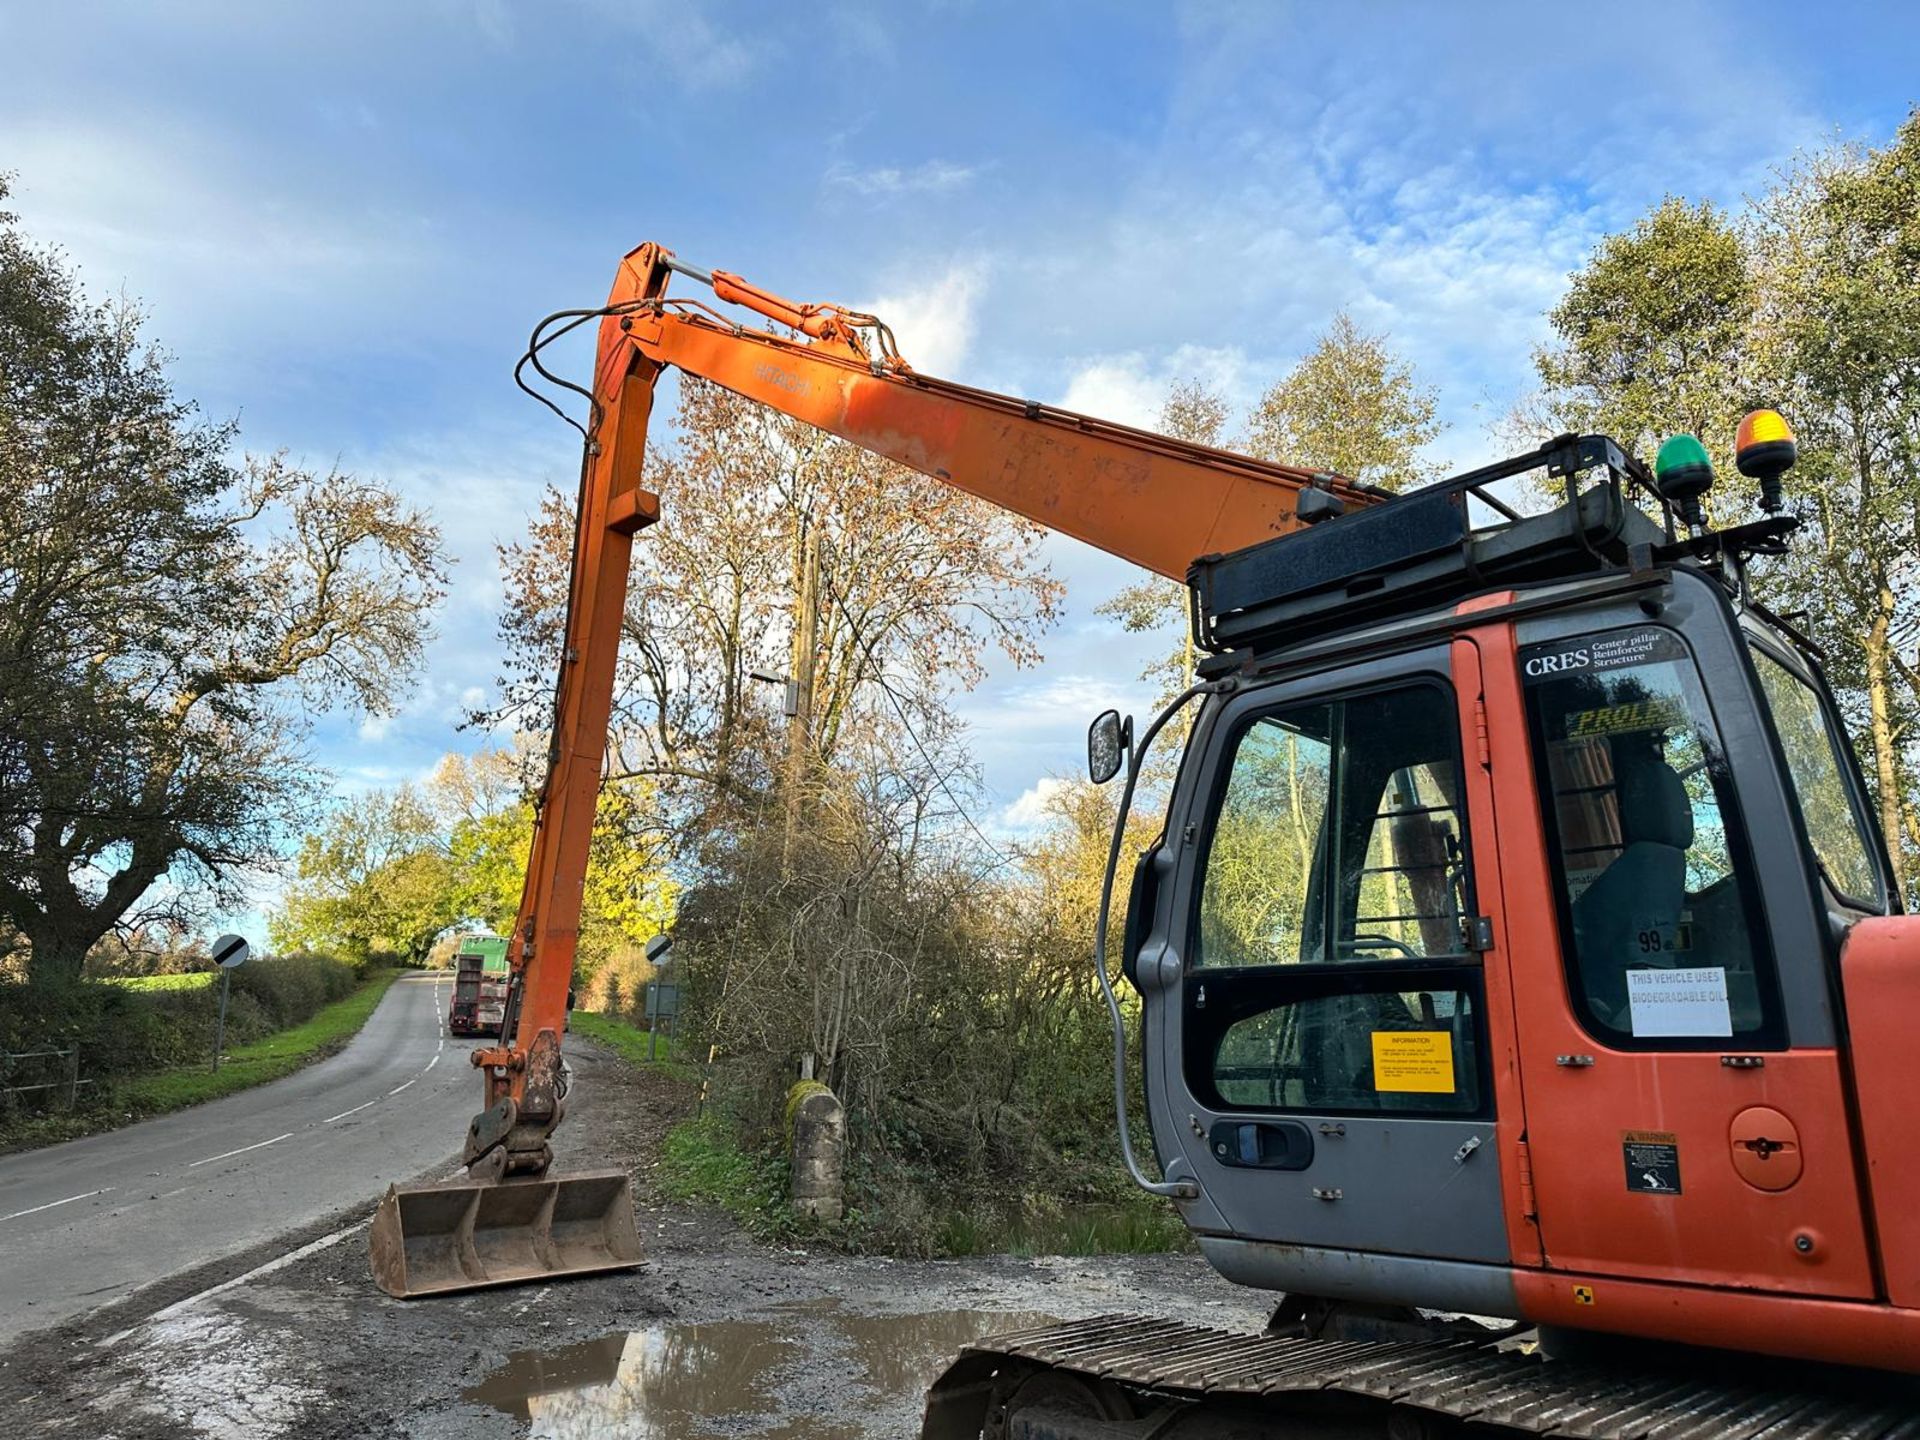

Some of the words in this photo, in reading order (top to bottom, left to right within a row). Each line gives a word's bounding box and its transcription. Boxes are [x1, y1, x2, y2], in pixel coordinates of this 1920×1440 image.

[754, 363, 812, 398] HITACHI
[1592, 640, 1627, 651] Center
[1630, 633, 1661, 647] pillar
[1593, 642, 1653, 660] Reinforced
[1525, 648, 1590, 676] CRES
[1594, 653, 1646, 668] Structure
[1638, 929, 1661, 953] 99
[1631, 974, 1652, 985] THIS
[1654, 972, 1693, 984] VEHICLE
[1696, 971, 1719, 983] USES
[1631, 991, 1708, 1004] BIODEGRADABLE
[1637, 1132, 1677, 1144] WARNING
